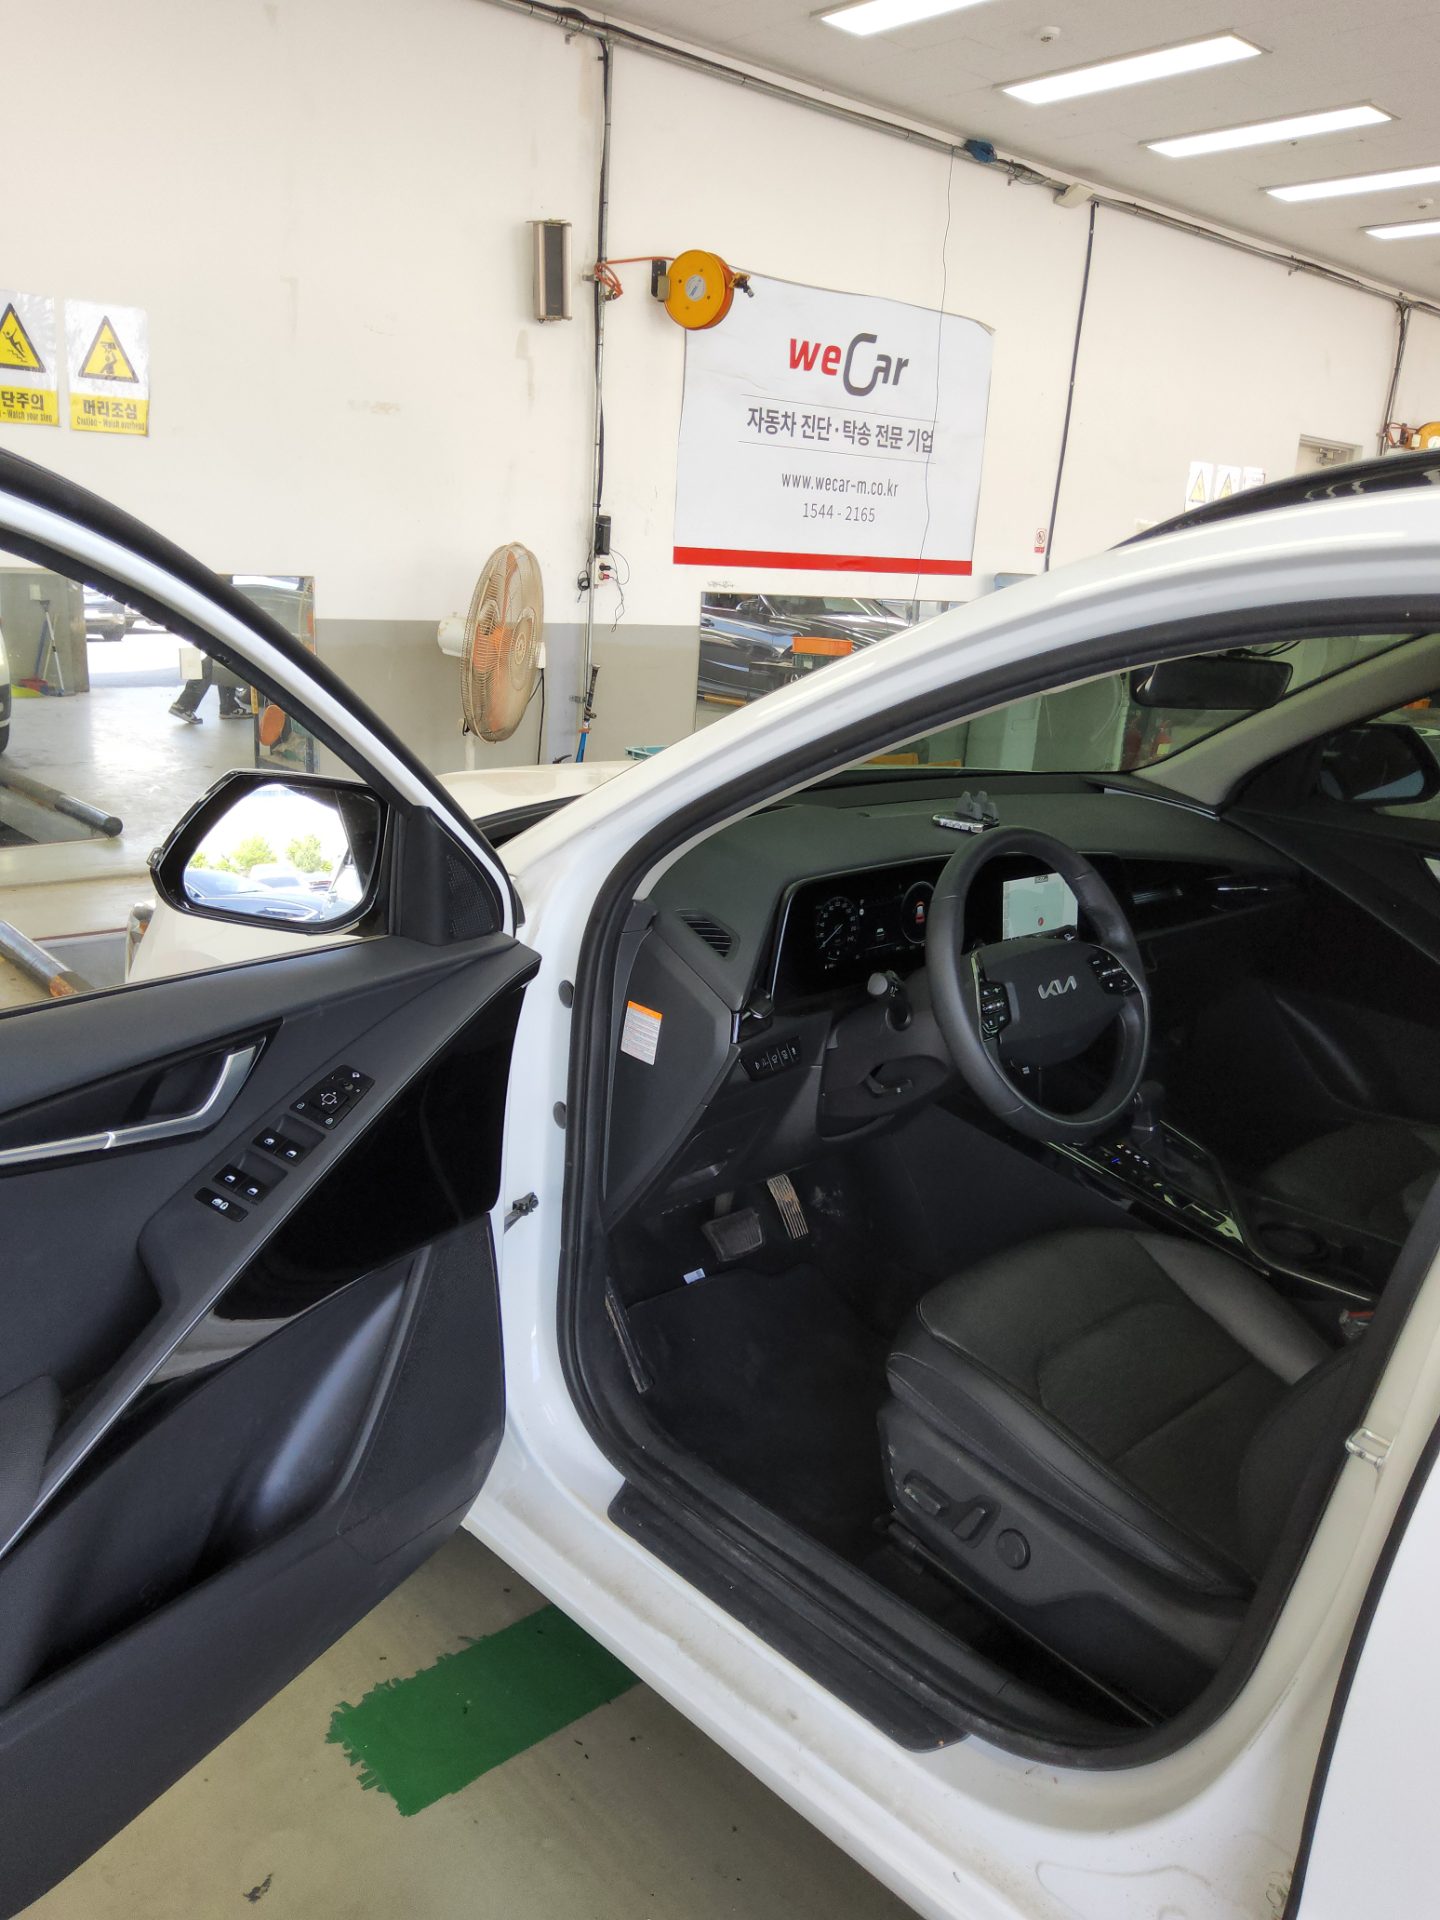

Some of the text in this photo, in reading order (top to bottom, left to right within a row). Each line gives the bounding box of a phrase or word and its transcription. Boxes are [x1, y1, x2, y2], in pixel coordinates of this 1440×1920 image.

[788, 332, 910, 397] weCar
[83, 399, 137, 420] 머리조심
[747, 406, 797, 438] 자동차
[875, 423, 903, 450] 전문
[907, 428, 934, 454] 기업
[782, 473, 899, 498] www.wecar-m.co.kr
[1037, 975, 1077, 1000] KIA
